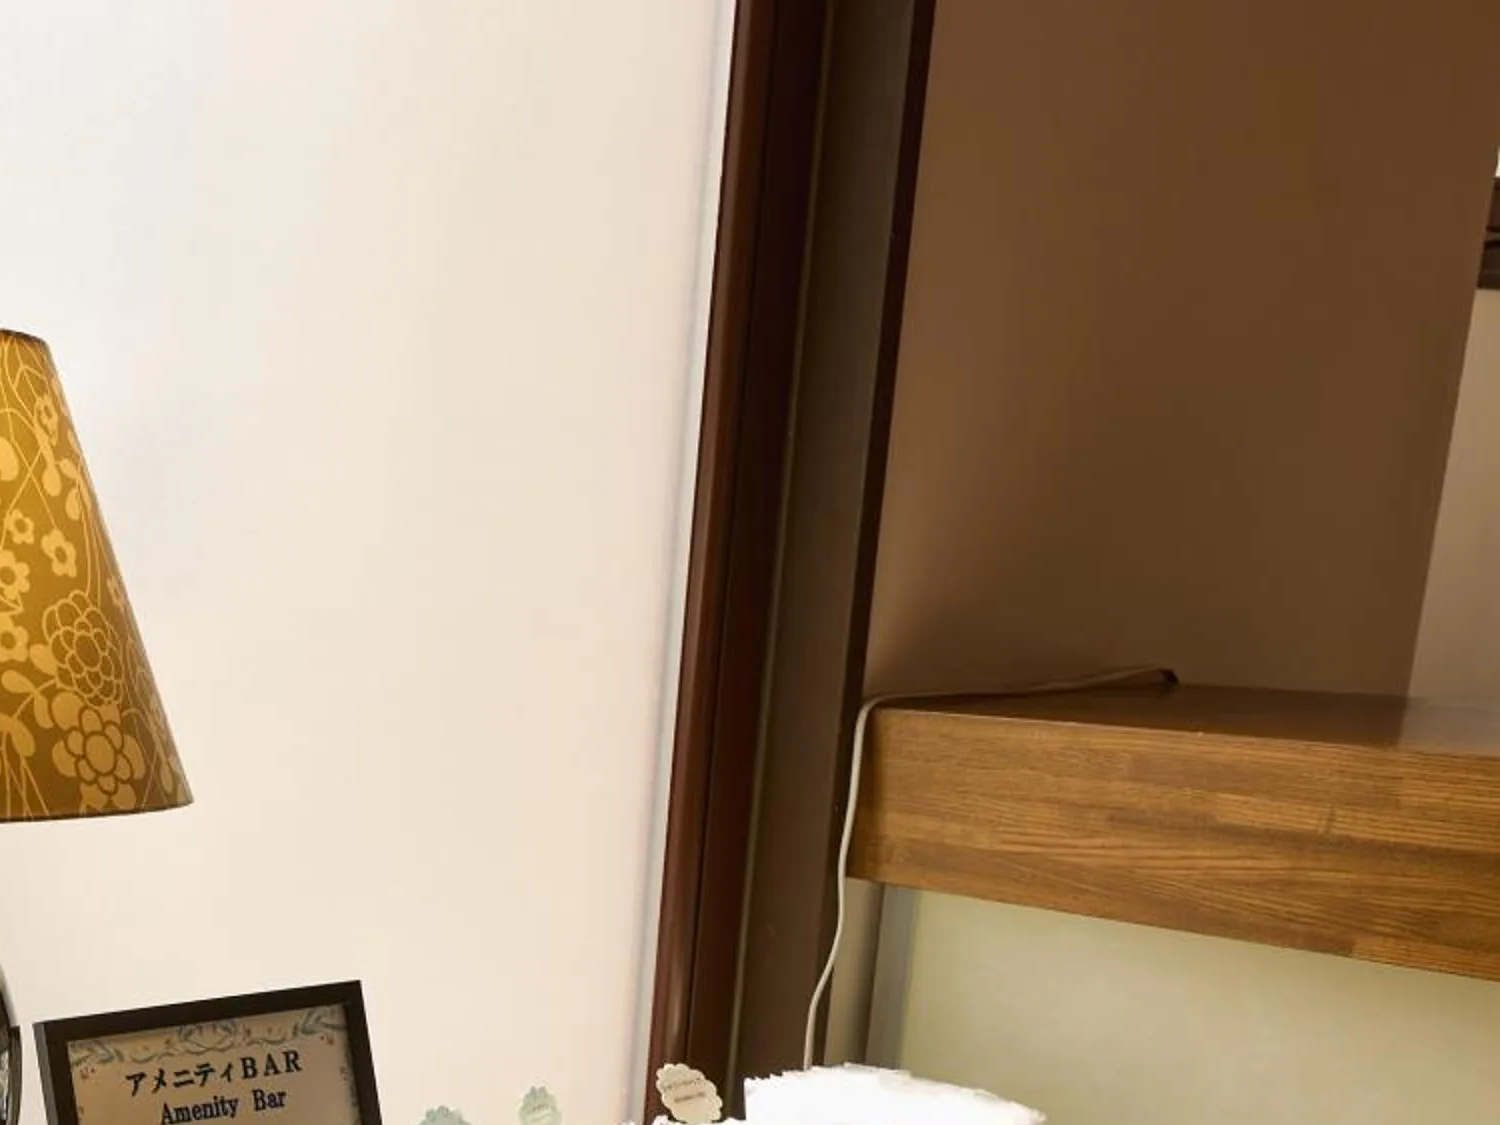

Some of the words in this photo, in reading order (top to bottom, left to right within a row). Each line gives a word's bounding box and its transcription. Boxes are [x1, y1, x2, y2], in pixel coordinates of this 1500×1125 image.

[125, 1049, 303, 1097] アメニティBAR
[160, 1095, 239, 1125] Amenity
[252, 1088, 287, 1112] Bar
